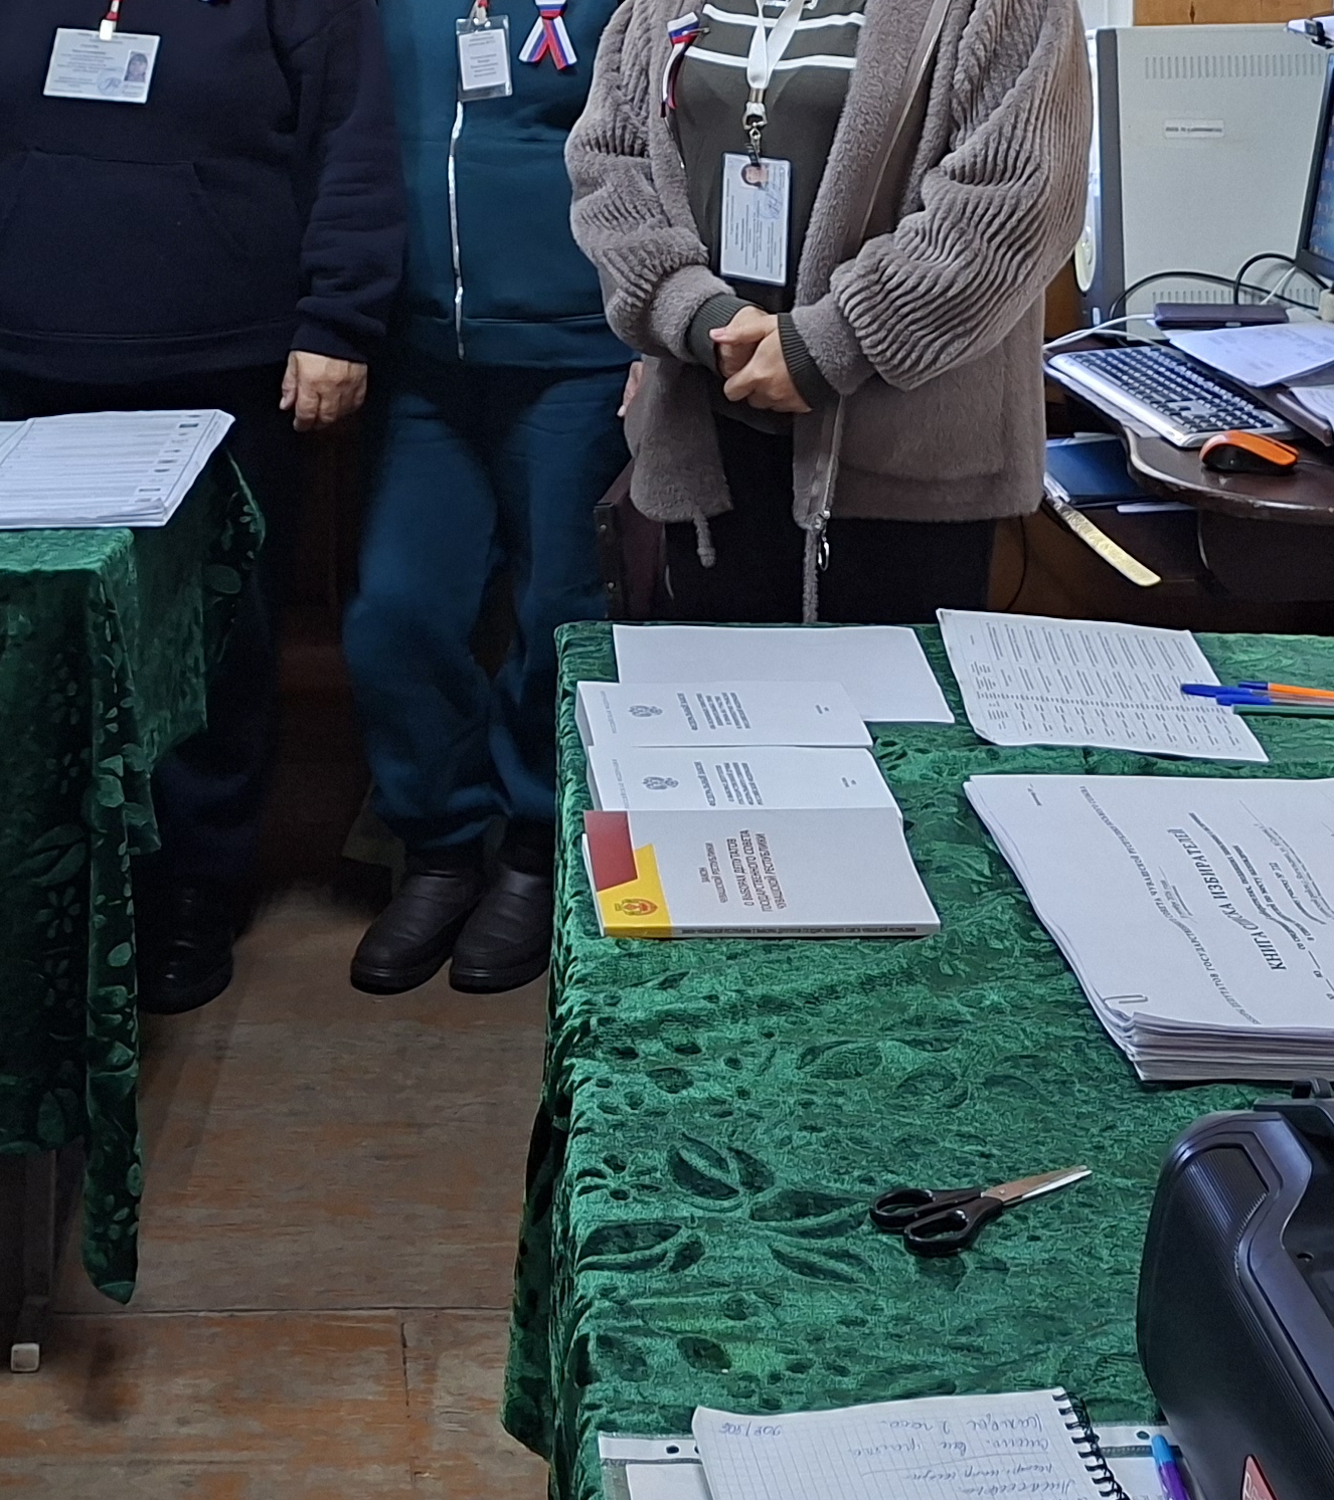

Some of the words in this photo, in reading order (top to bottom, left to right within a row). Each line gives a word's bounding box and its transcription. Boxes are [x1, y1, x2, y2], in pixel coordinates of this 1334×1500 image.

[727, 838, 747, 874] ДЕПУТАТОВ
[740, 830, 755, 855] СОВЕТА
[756, 834, 775, 874] РЕСПУБЛИКИ
[1167, 827, 1228, 898] ИЗБИРАТЕЛЕЙ
[736, 875, 753, 900] ВЫБОРАХ
[746, 856, 773, 912] ГОСУДАРСТВЕННОГО
[765, 875, 786, 909] ЧУВАШСКОЙ
[1250, 930, 1286, 970] КНИГА
